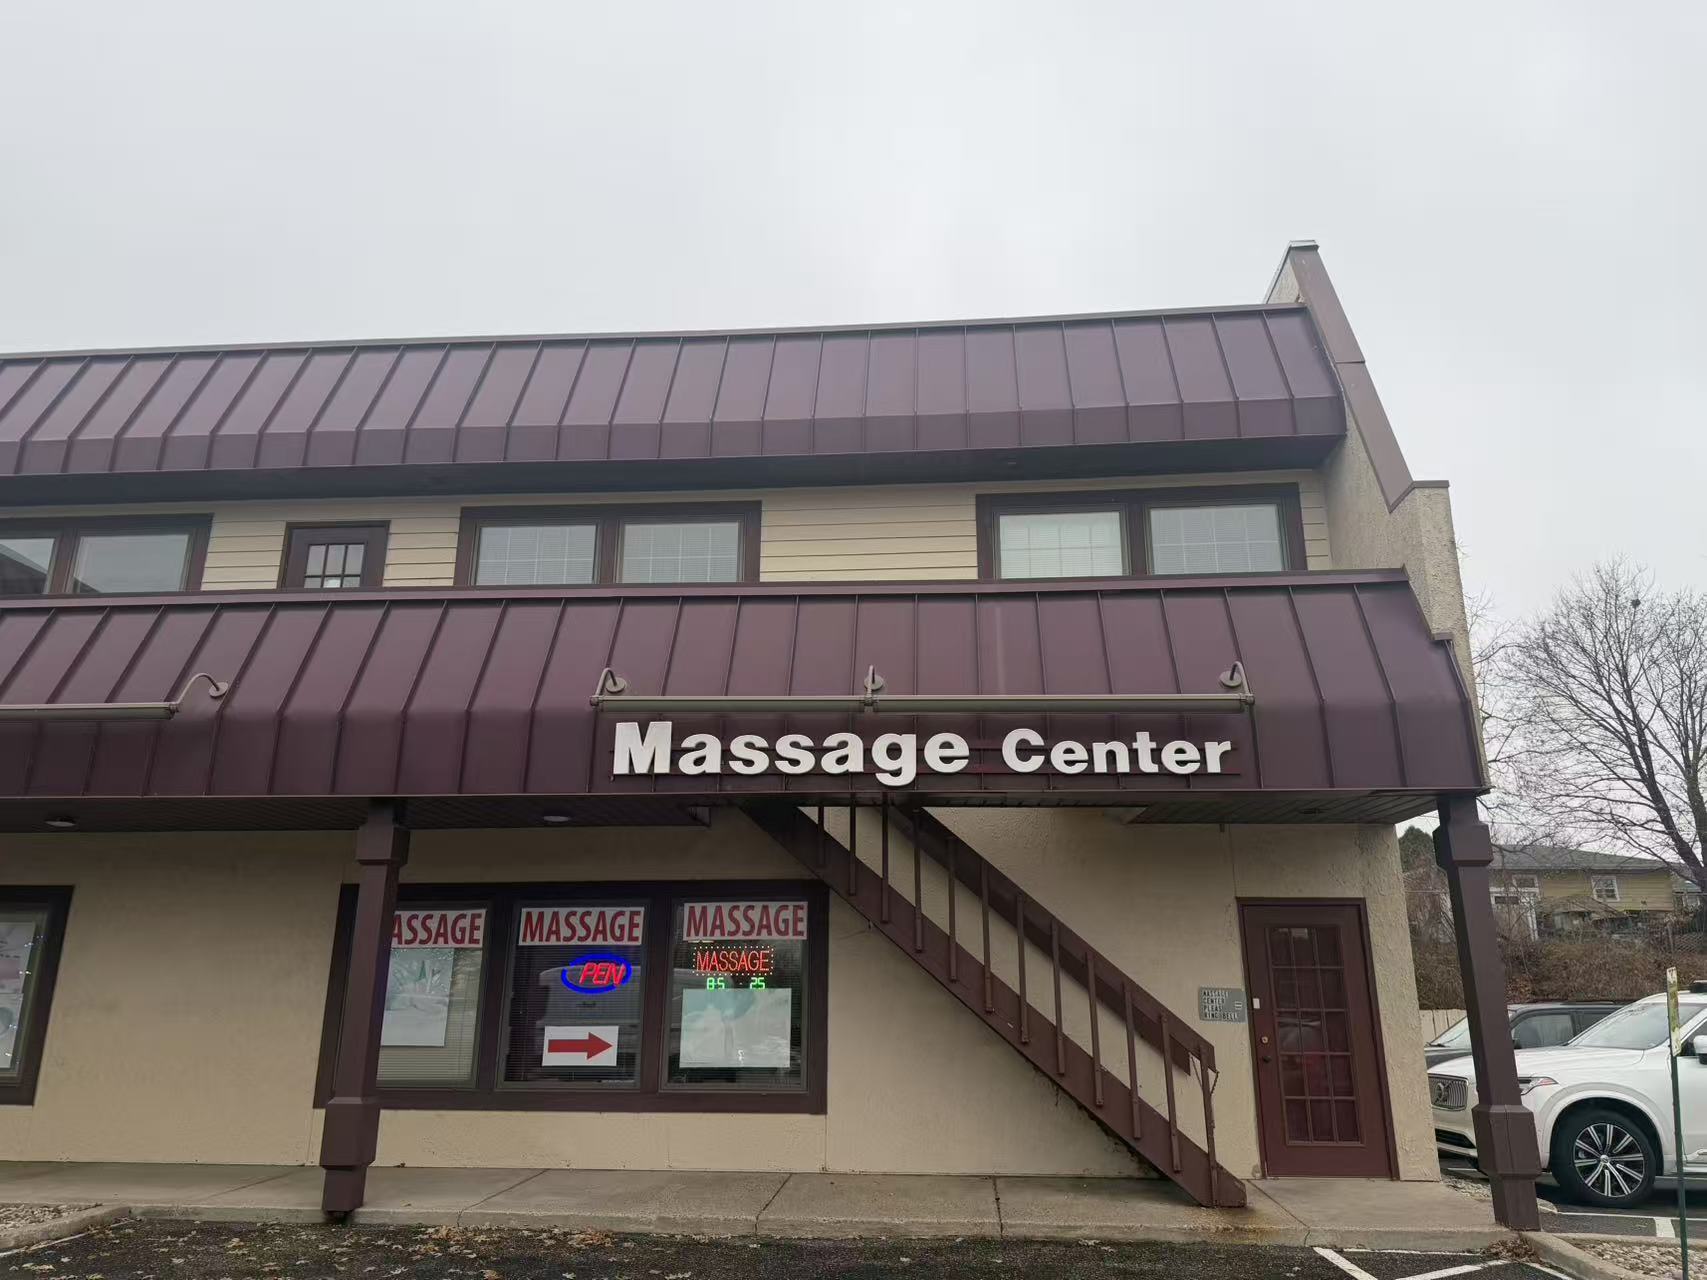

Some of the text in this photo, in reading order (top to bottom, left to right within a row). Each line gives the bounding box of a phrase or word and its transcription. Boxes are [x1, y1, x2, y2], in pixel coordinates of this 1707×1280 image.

[613, 721, 1231, 786] Massage Center
[391, 913, 482, 945] ASSAGE
[521, 911, 641, 943] MASSAGE
[686, 904, 804, 937] MASSAGE
[696, 950, 770, 971] MASSAGE
